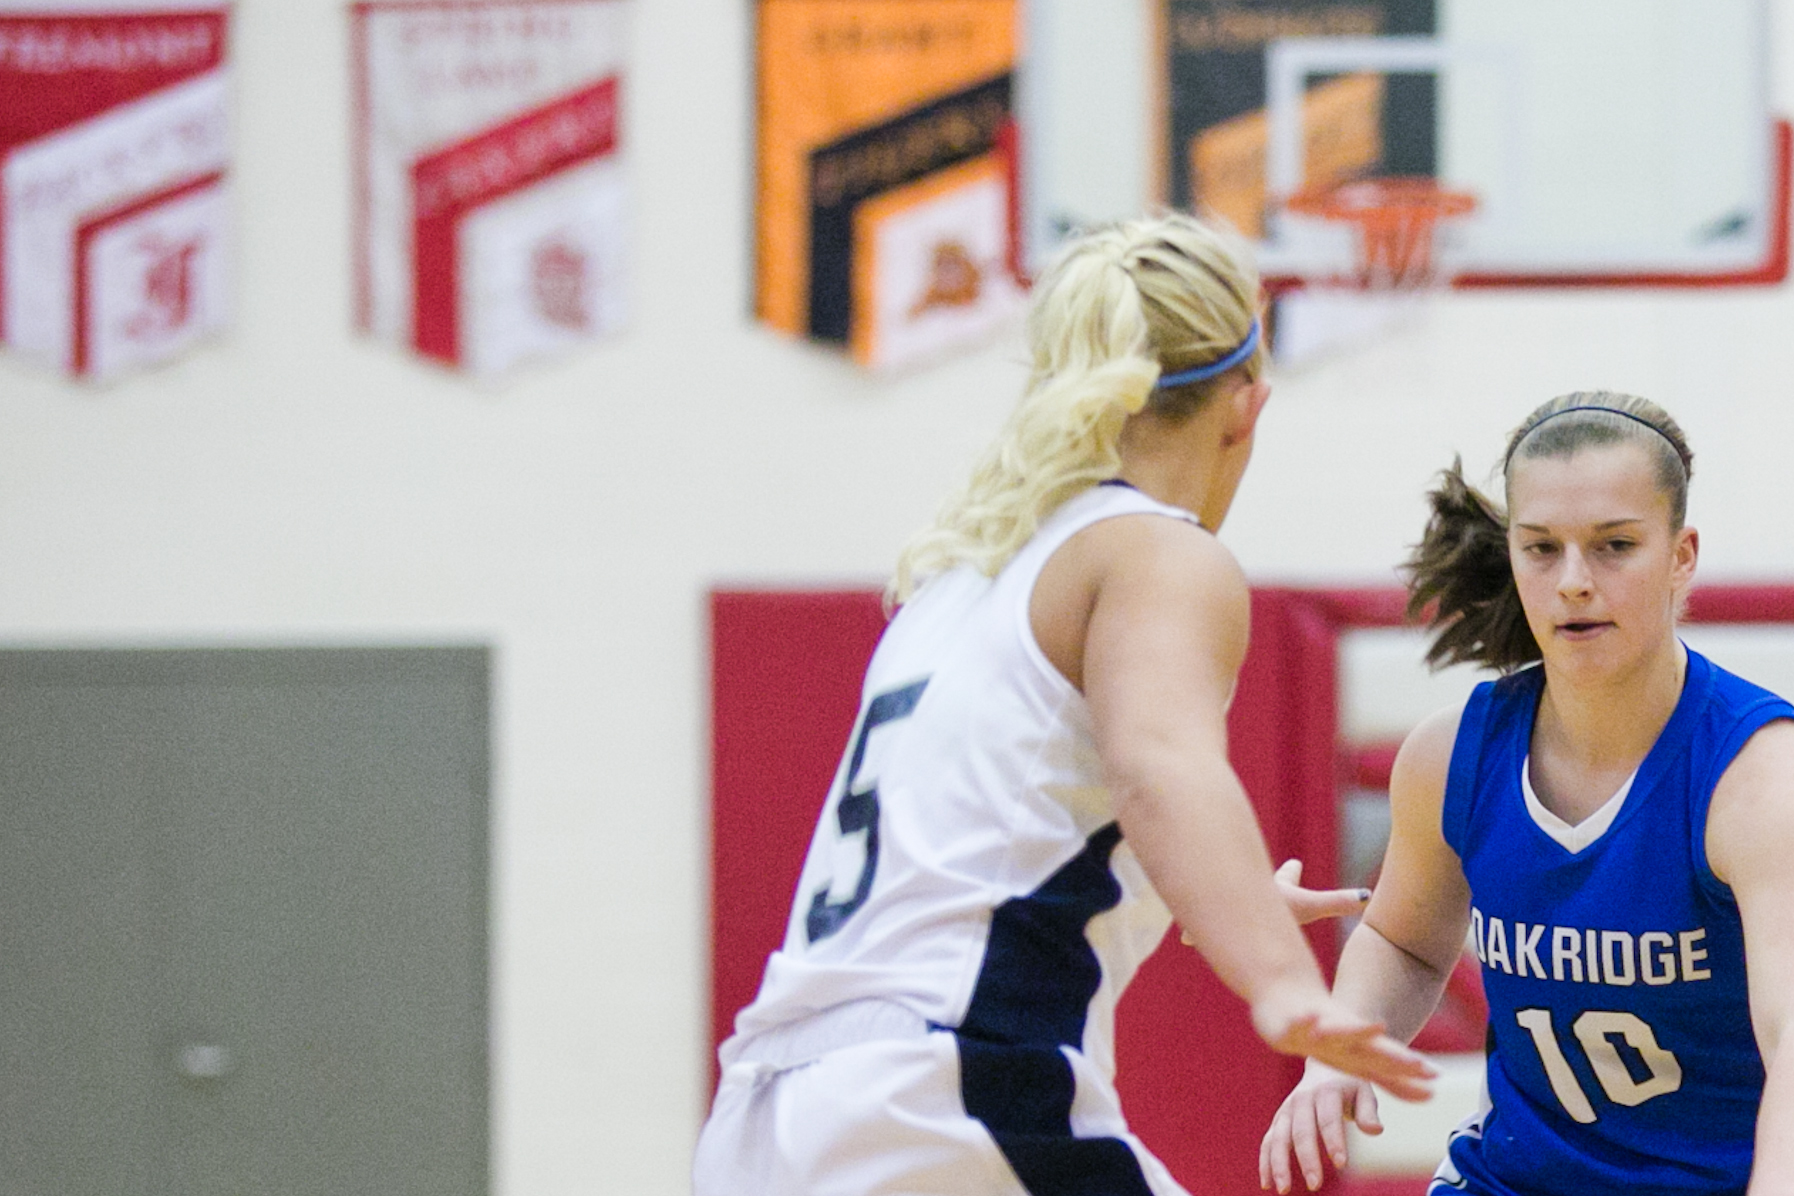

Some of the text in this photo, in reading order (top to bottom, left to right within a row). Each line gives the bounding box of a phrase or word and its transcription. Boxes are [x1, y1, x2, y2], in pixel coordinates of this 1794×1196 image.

[806, 676, 932, 945] 5
[1471, 905, 1712, 986] OAKRIDGE
[1515, 1008, 1683, 1124] 10
